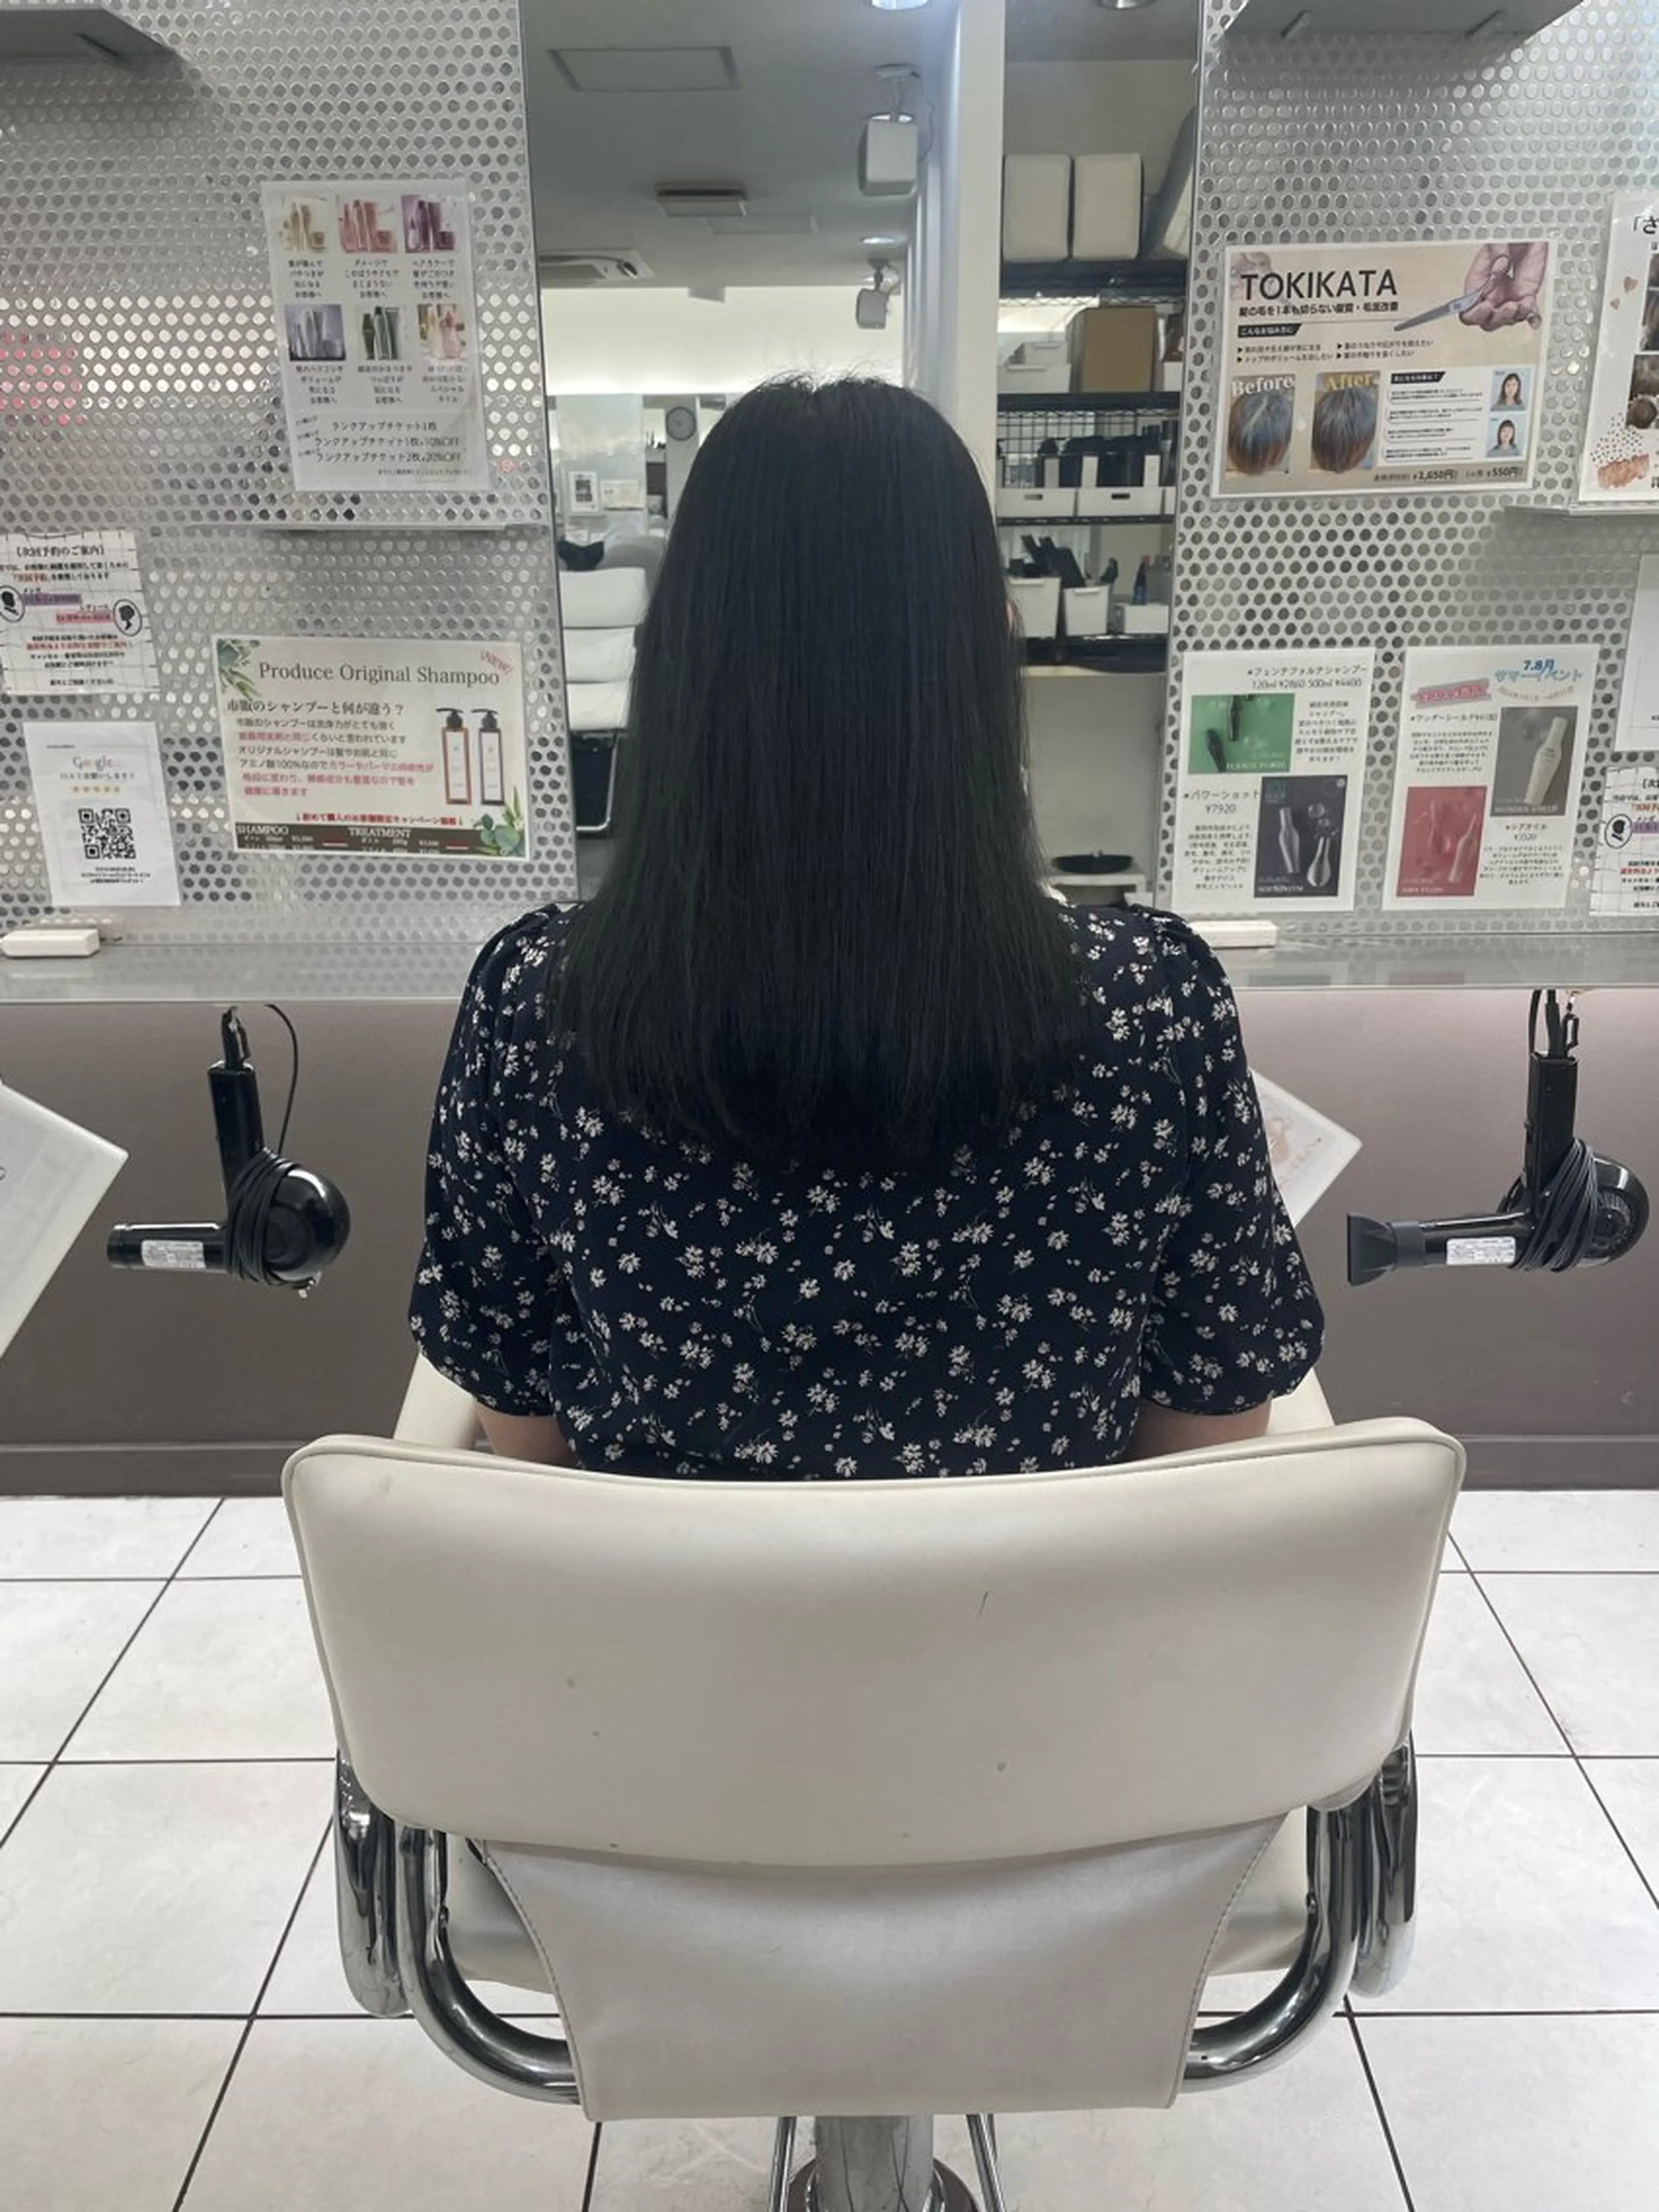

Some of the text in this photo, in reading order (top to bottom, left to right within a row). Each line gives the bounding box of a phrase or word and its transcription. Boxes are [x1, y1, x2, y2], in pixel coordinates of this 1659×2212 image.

[1633, 216, 1659, 234] 「さ
[1241, 269, 1396, 300] TOKIKATA
[1232, 376, 1294, 396] Before
[1324, 374, 1373, 391] After
[1524, 659, 1555, 673] 7.8月
[259, 662, 500, 688] Produce Original Shampoo
[1495, 669, 1583, 682] サマーイベント
[73, 755, 116, 772] Google
[237, 825, 289, 836] SHAMPOO
[349, 827, 410, 838] TREATMENT
